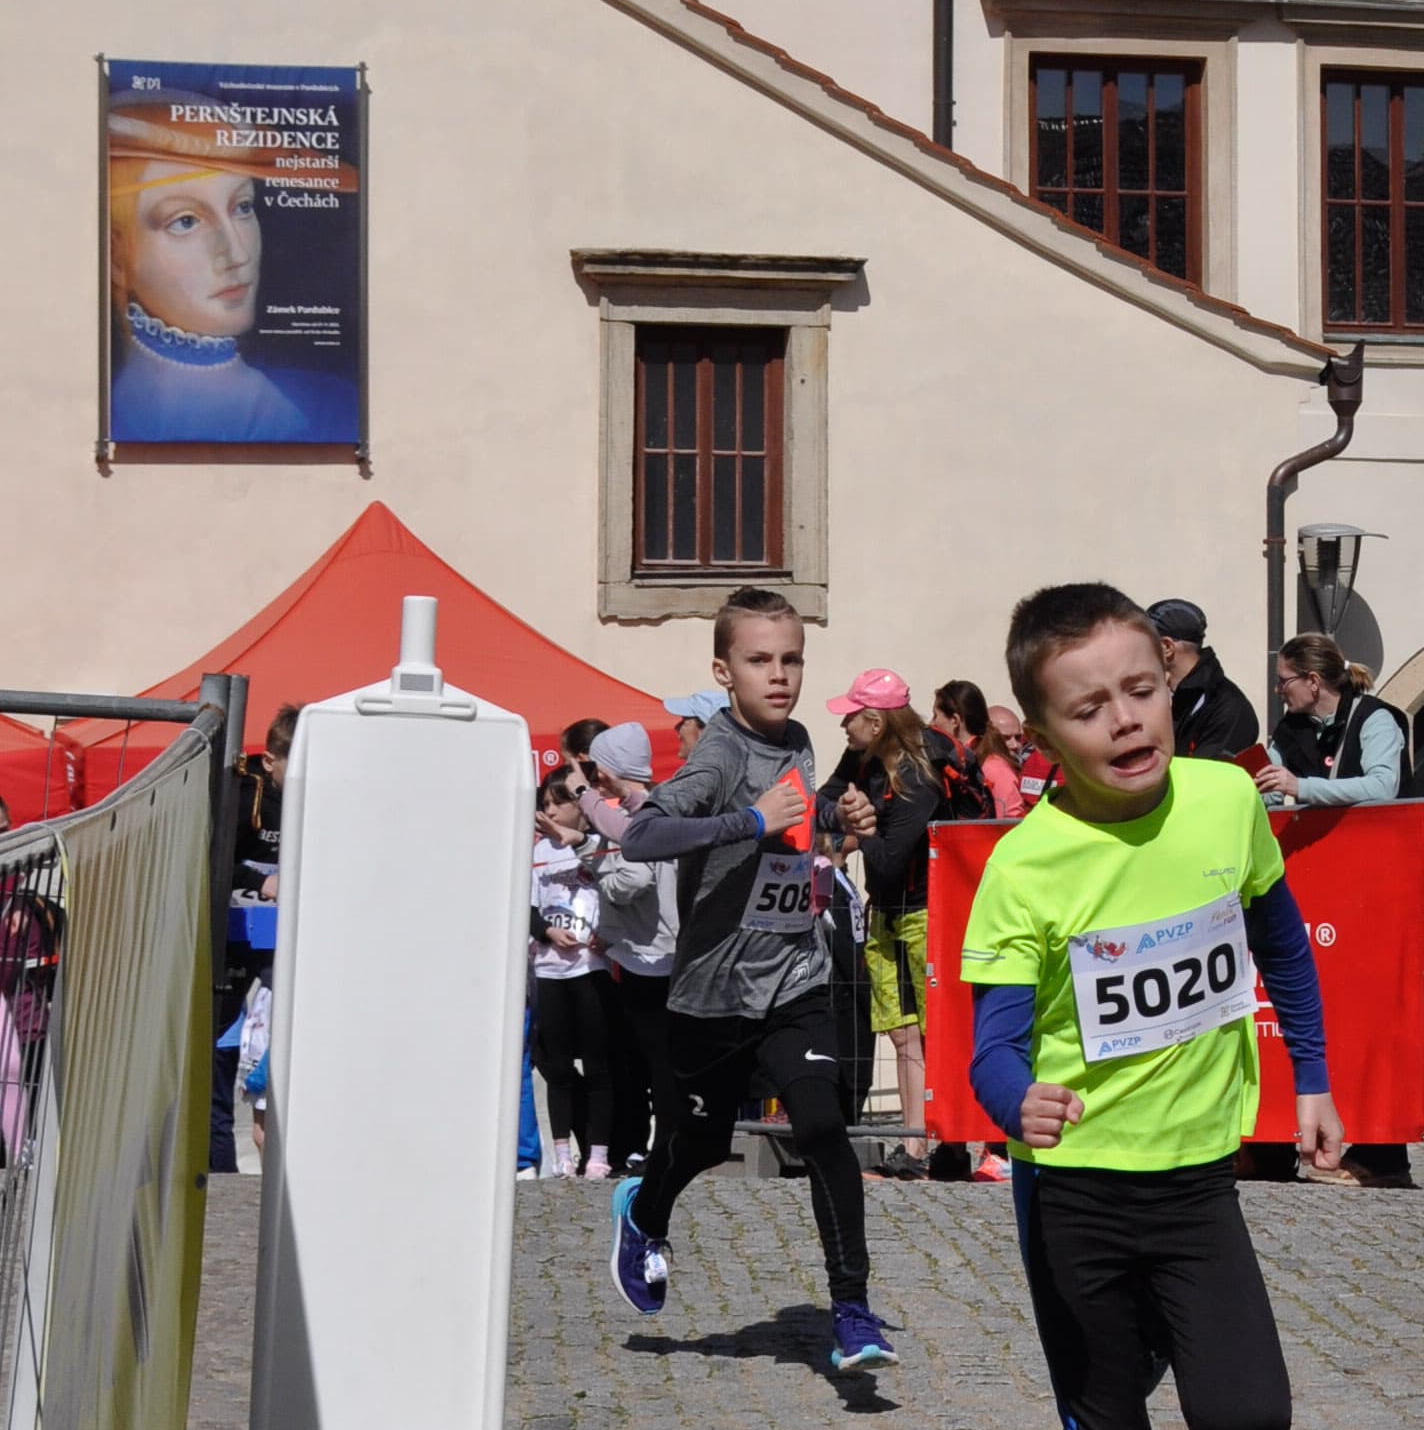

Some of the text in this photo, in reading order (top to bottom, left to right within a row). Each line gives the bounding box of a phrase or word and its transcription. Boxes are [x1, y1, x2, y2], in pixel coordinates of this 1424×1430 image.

[170, 103, 340, 126] PERNŠTEJNSKÁ
[216, 129, 340, 149] REZIDENCE
[275, 154, 340, 171] nejstarší
[265, 176, 340, 189] renesance
[264, 191, 340, 208] v Čechách
[1156, 922, 1194, 942] PVZP
[1096, 943, 1236, 1025] 5020
